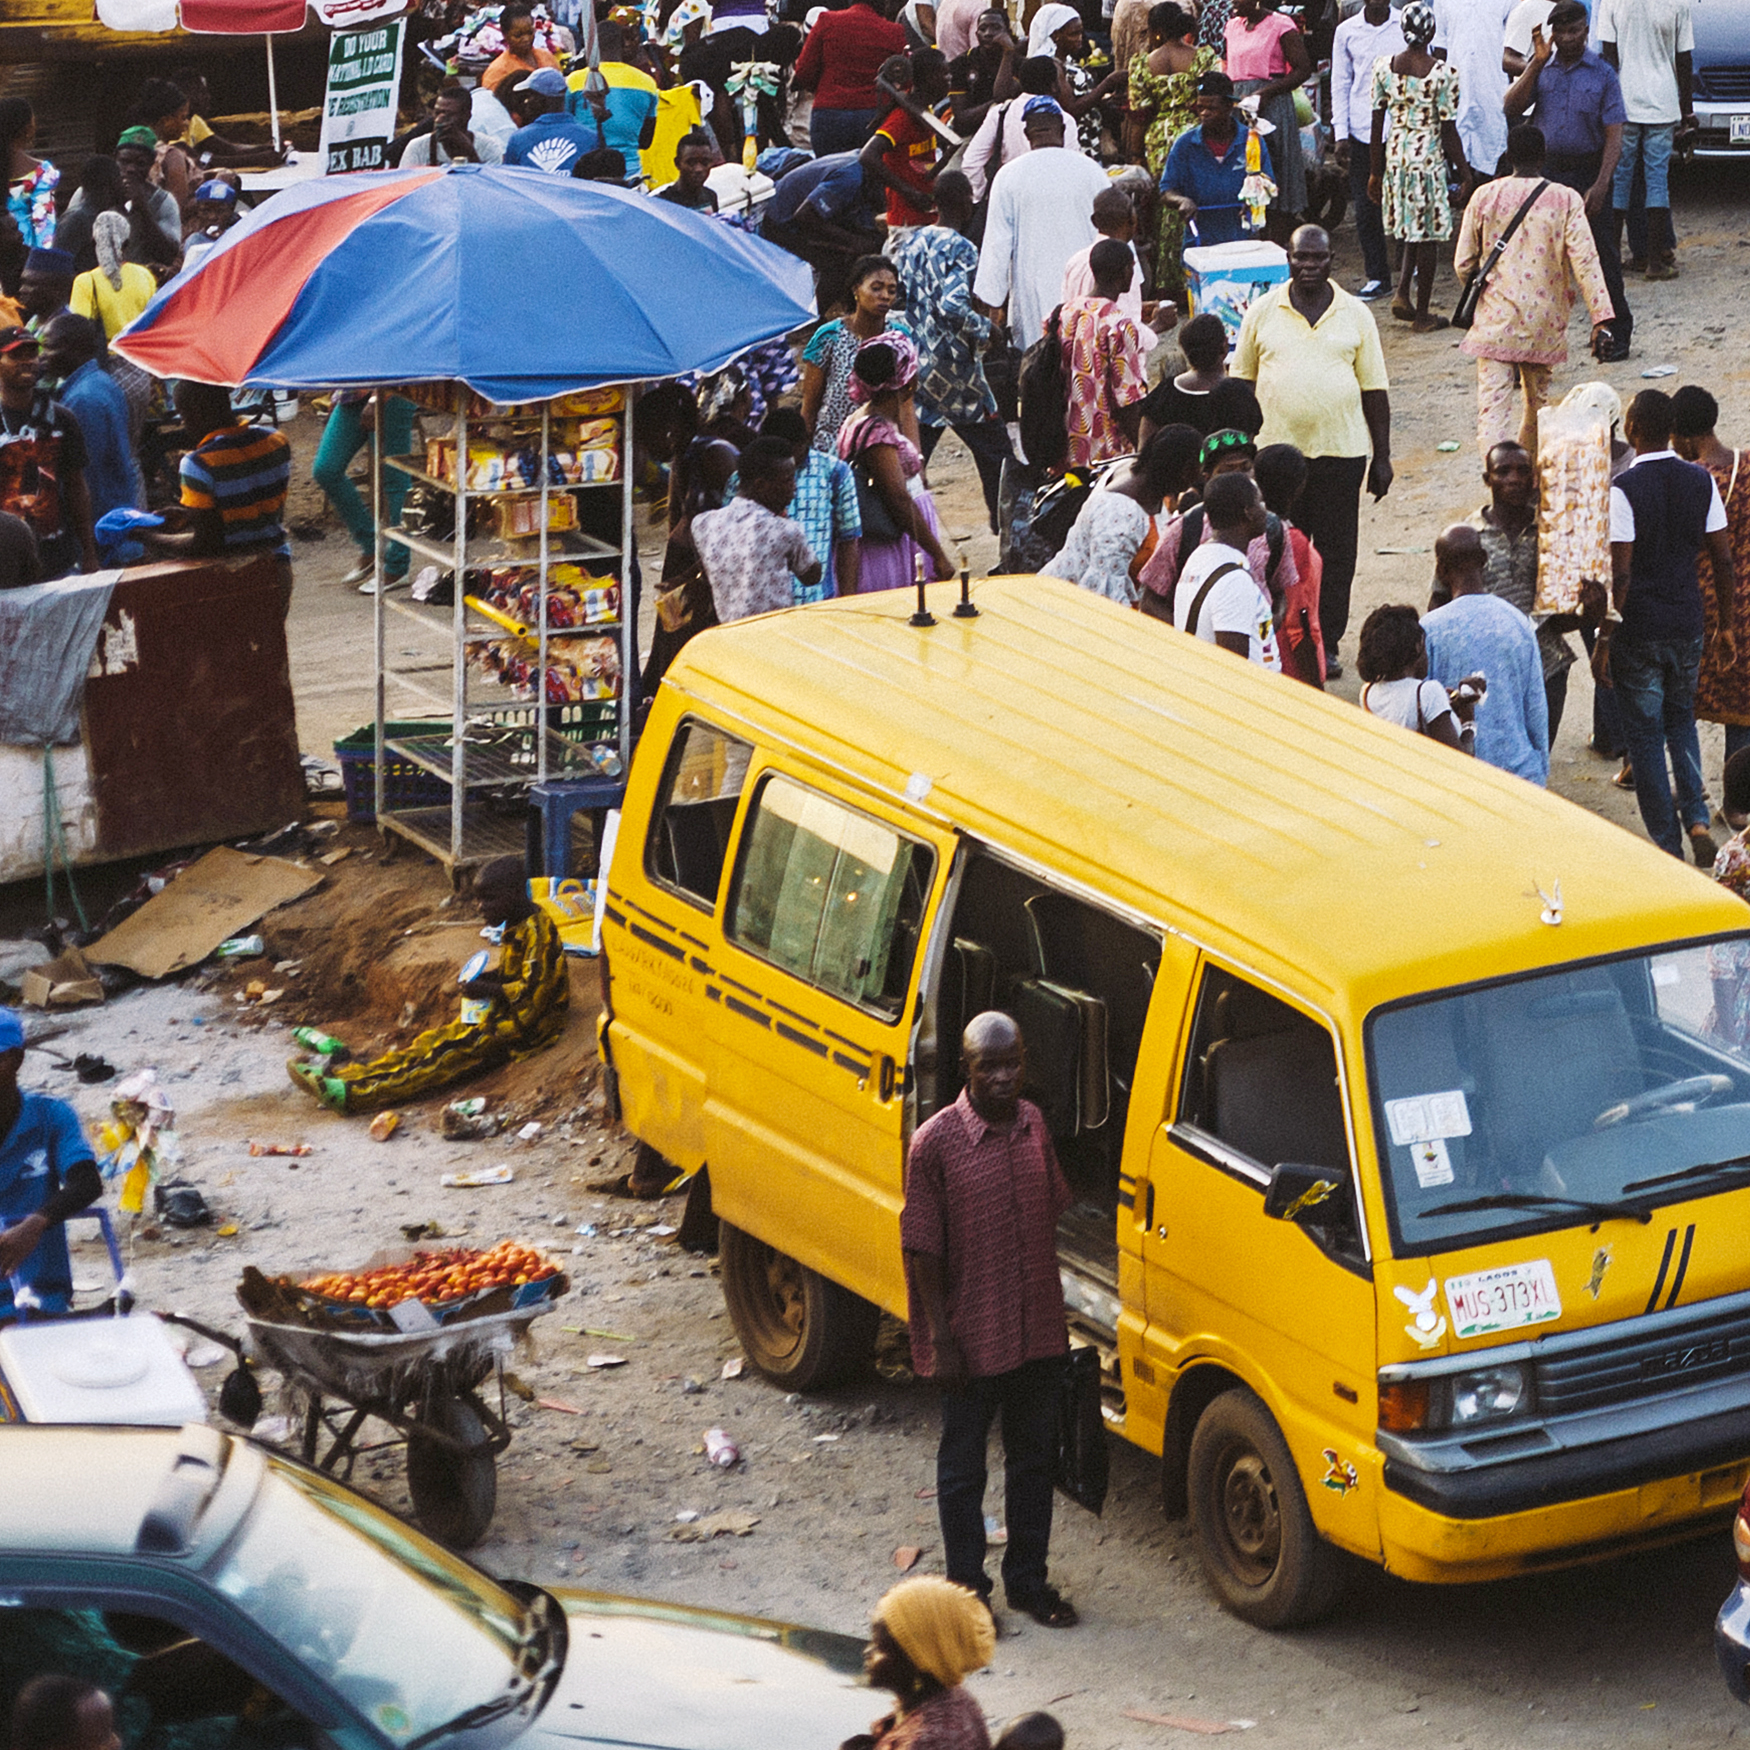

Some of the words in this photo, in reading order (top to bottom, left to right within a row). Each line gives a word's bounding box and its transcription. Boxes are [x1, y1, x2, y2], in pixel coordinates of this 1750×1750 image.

[343, 36, 357, 58] DO
[358, 29, 388, 55] YOUR
[1453, 1278, 1556, 1323] MUS-373XL
